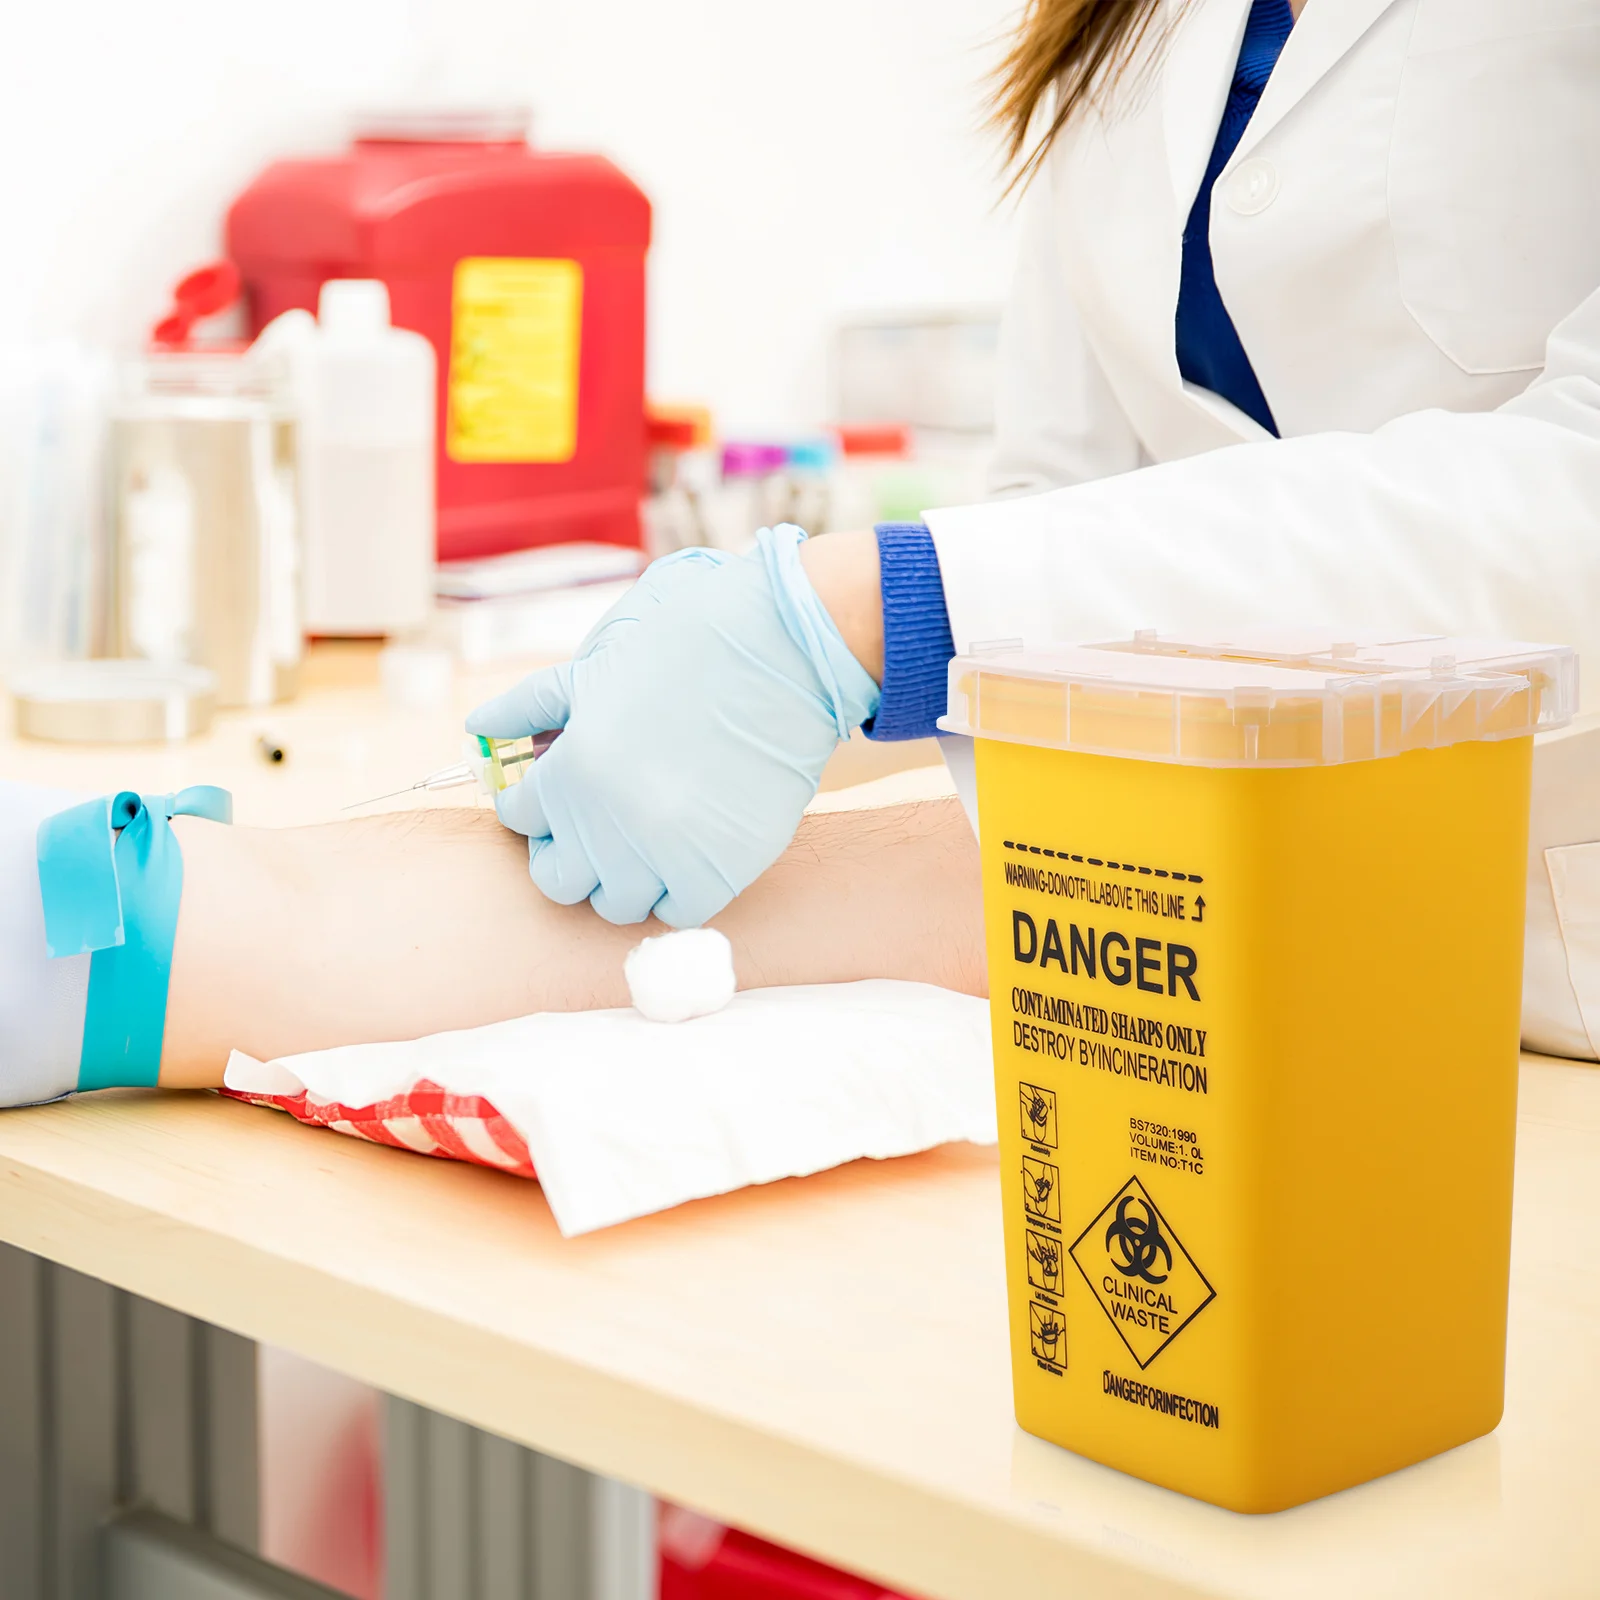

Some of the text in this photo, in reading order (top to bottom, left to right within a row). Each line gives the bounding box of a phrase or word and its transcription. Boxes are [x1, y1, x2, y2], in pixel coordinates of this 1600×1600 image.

[1135, 888, 1158, 915] THIS
[1161, 895, 1185, 920] LINE
[1012, 909, 1201, 1001] DANGER
[1012, 987, 1208, 1057] CONTAMINATED SHARPS ONLY
[1013, 1020, 1076, 1062] DESTROY
[1130, 1117, 1197, 1144] BS7320:1990
[1130, 1146, 1204, 1175] ITEM NO:T1C
[1102, 1276, 1178, 1314] CLINICAL
[1110, 1300, 1170, 1335] WASTE
